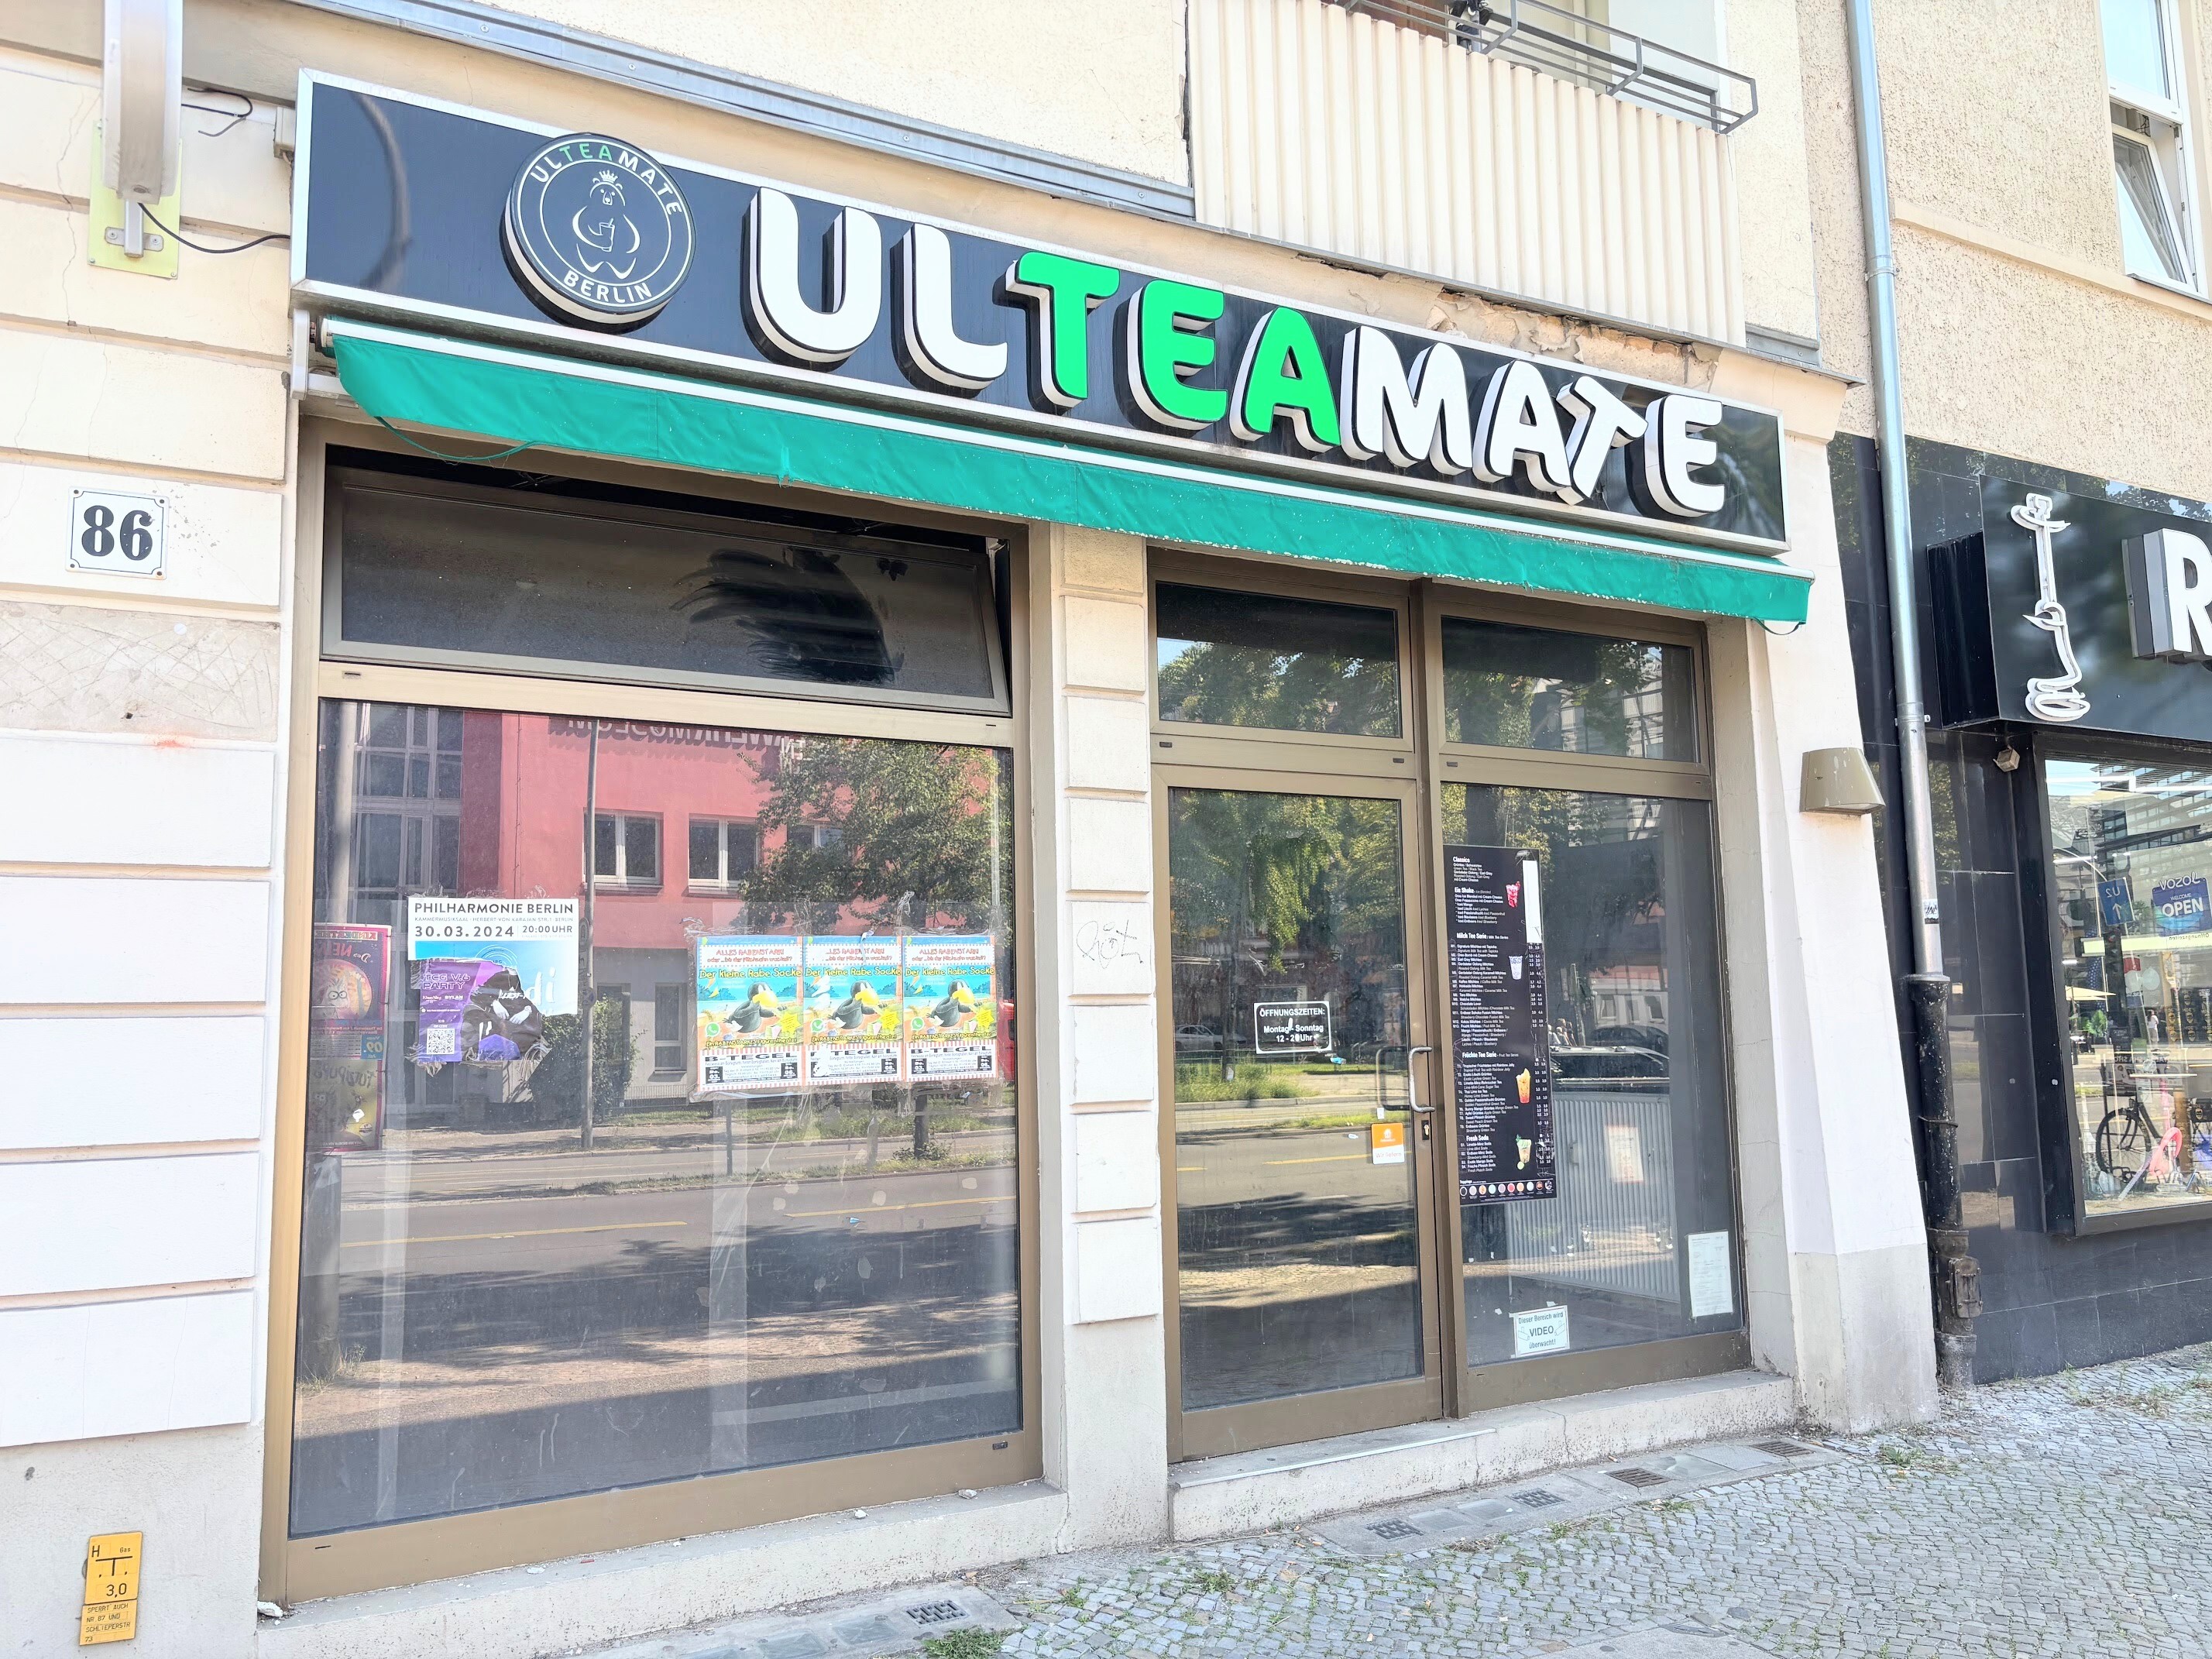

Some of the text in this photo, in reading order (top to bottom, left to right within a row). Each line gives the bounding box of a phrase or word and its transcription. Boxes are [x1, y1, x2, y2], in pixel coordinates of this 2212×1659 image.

[531, 144, 682, 216] ULTEAMATE
[564, 270, 652, 303] BERLIN
[748, 187, 1725, 517] ULTEAMATE
[81, 505, 153, 561] 86
[414, 903, 573, 914] PHILHARMONIE BERLIN
[2162, 897, 2204, 917] OPEN
[414, 926, 514, 937] 30.03.2024
[699, 970, 716, 979] Der
[747, 968, 771, 977] Rabe
[772, 968, 802, 977] Socke
[805, 968, 821, 977] Der
[850, 967, 872, 976] Rabe
[874, 966, 902, 975] Socke
[947, 967, 968, 975] Rabe
[969, 966, 995, 975] Socke
[1259, 1008, 1325, 1017] ÖFFNUNGSZEITEN:
[1263, 1025, 1290, 1034] Montag
[705, 1053, 798, 1061] B-TEGEL
[1534, 1314, 1552, 1322] Bereich
[1529, 1325, 1554, 1337] VIDEO
[1529, 1339, 1556, 1349] überwacht!
[91, 1545, 100, 1558] H
[106, 1583, 127, 1598] 3,0
[88, 1605, 109, 1613] SPERRT
